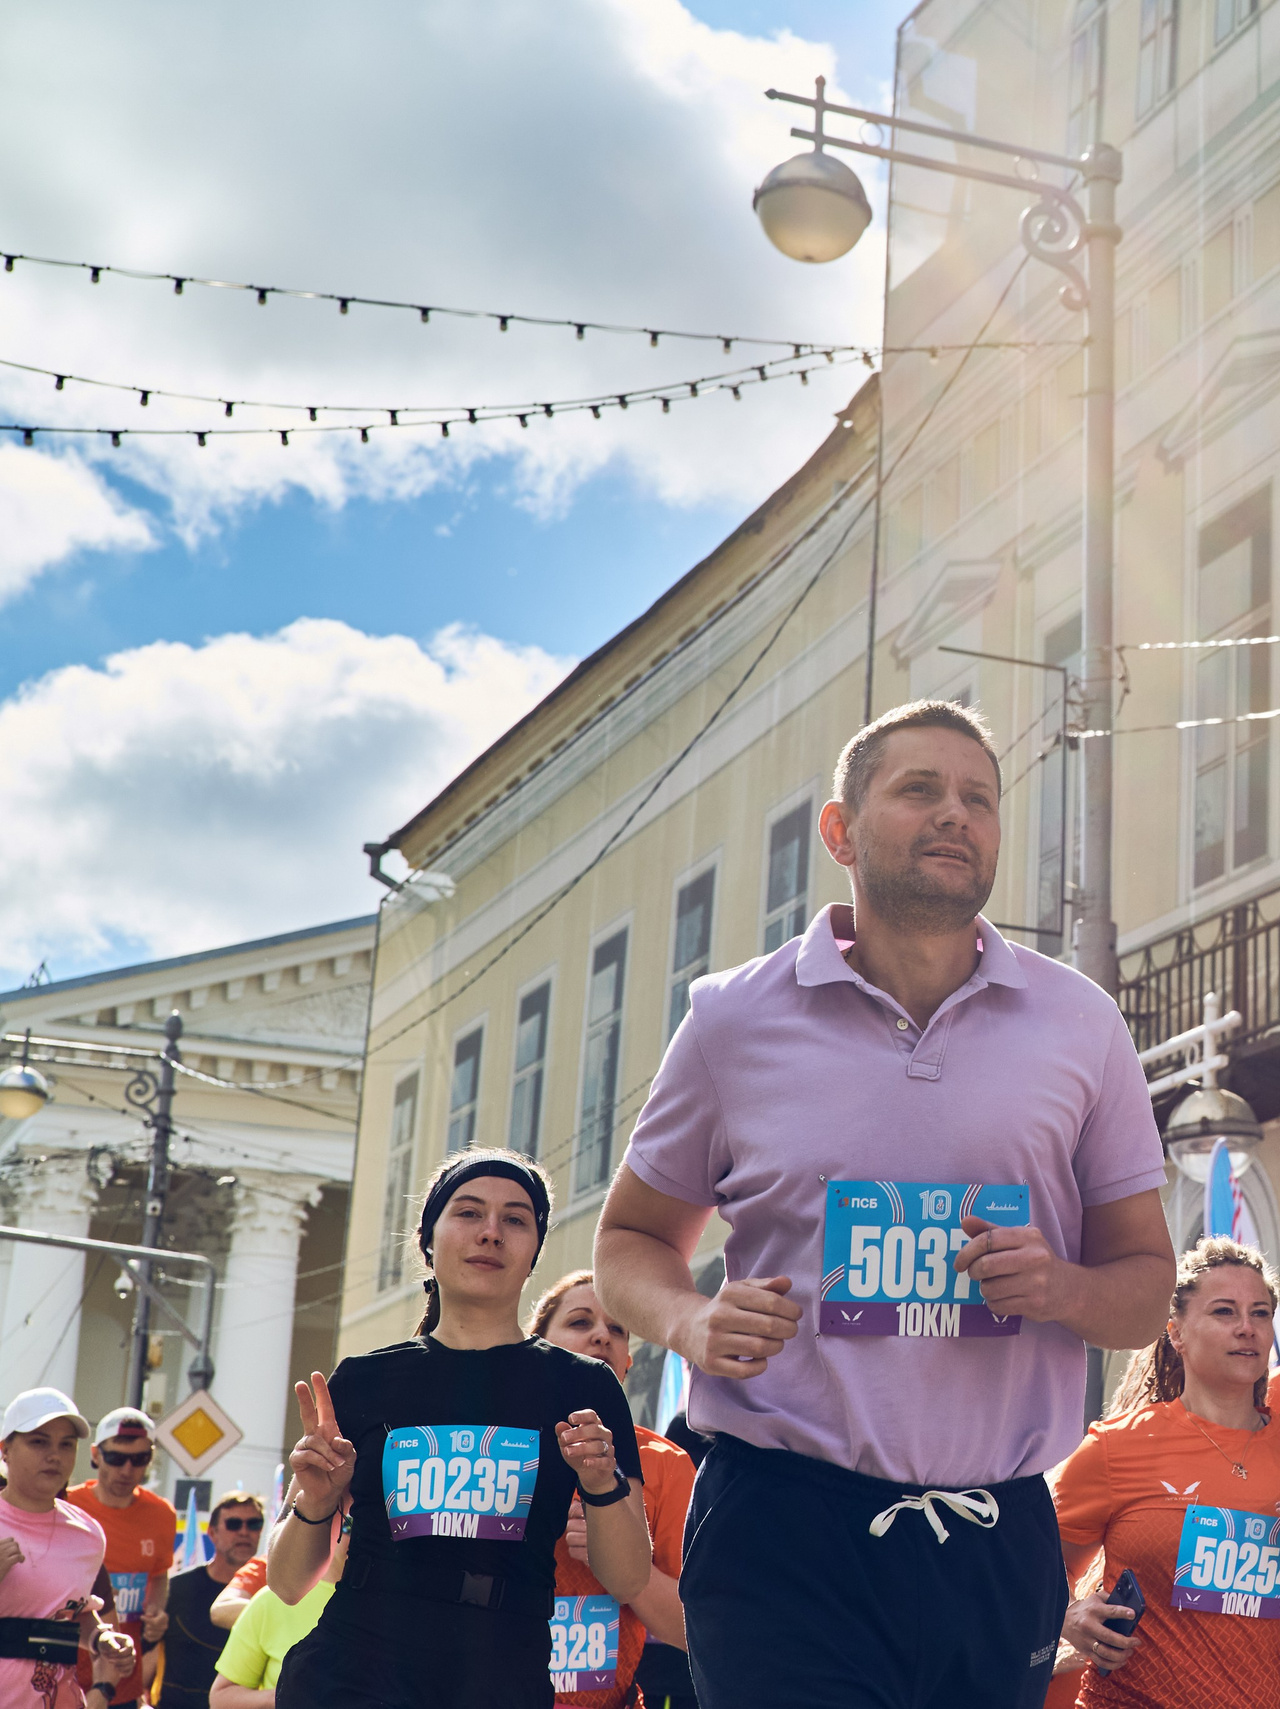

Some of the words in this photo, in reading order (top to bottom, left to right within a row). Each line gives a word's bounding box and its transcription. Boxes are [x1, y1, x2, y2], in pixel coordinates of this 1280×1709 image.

[851, 1198, 878, 1209] ПСБ
[919, 1189, 952, 1220] 10
[848, 1225, 985, 1300] 5037
[896, 1302, 961, 1337] 10KM
[399, 1439, 419, 1449] ПСБ
[449, 1430, 475, 1453] 10
[396, 1456, 521, 1514] 50235
[430, 1511, 480, 1539] 10KM
[1200, 1517, 1218, 1527] ПСБ
[1244, 1517, 1267, 1540] 10
[1221, 1592, 1263, 1618] 10KM
